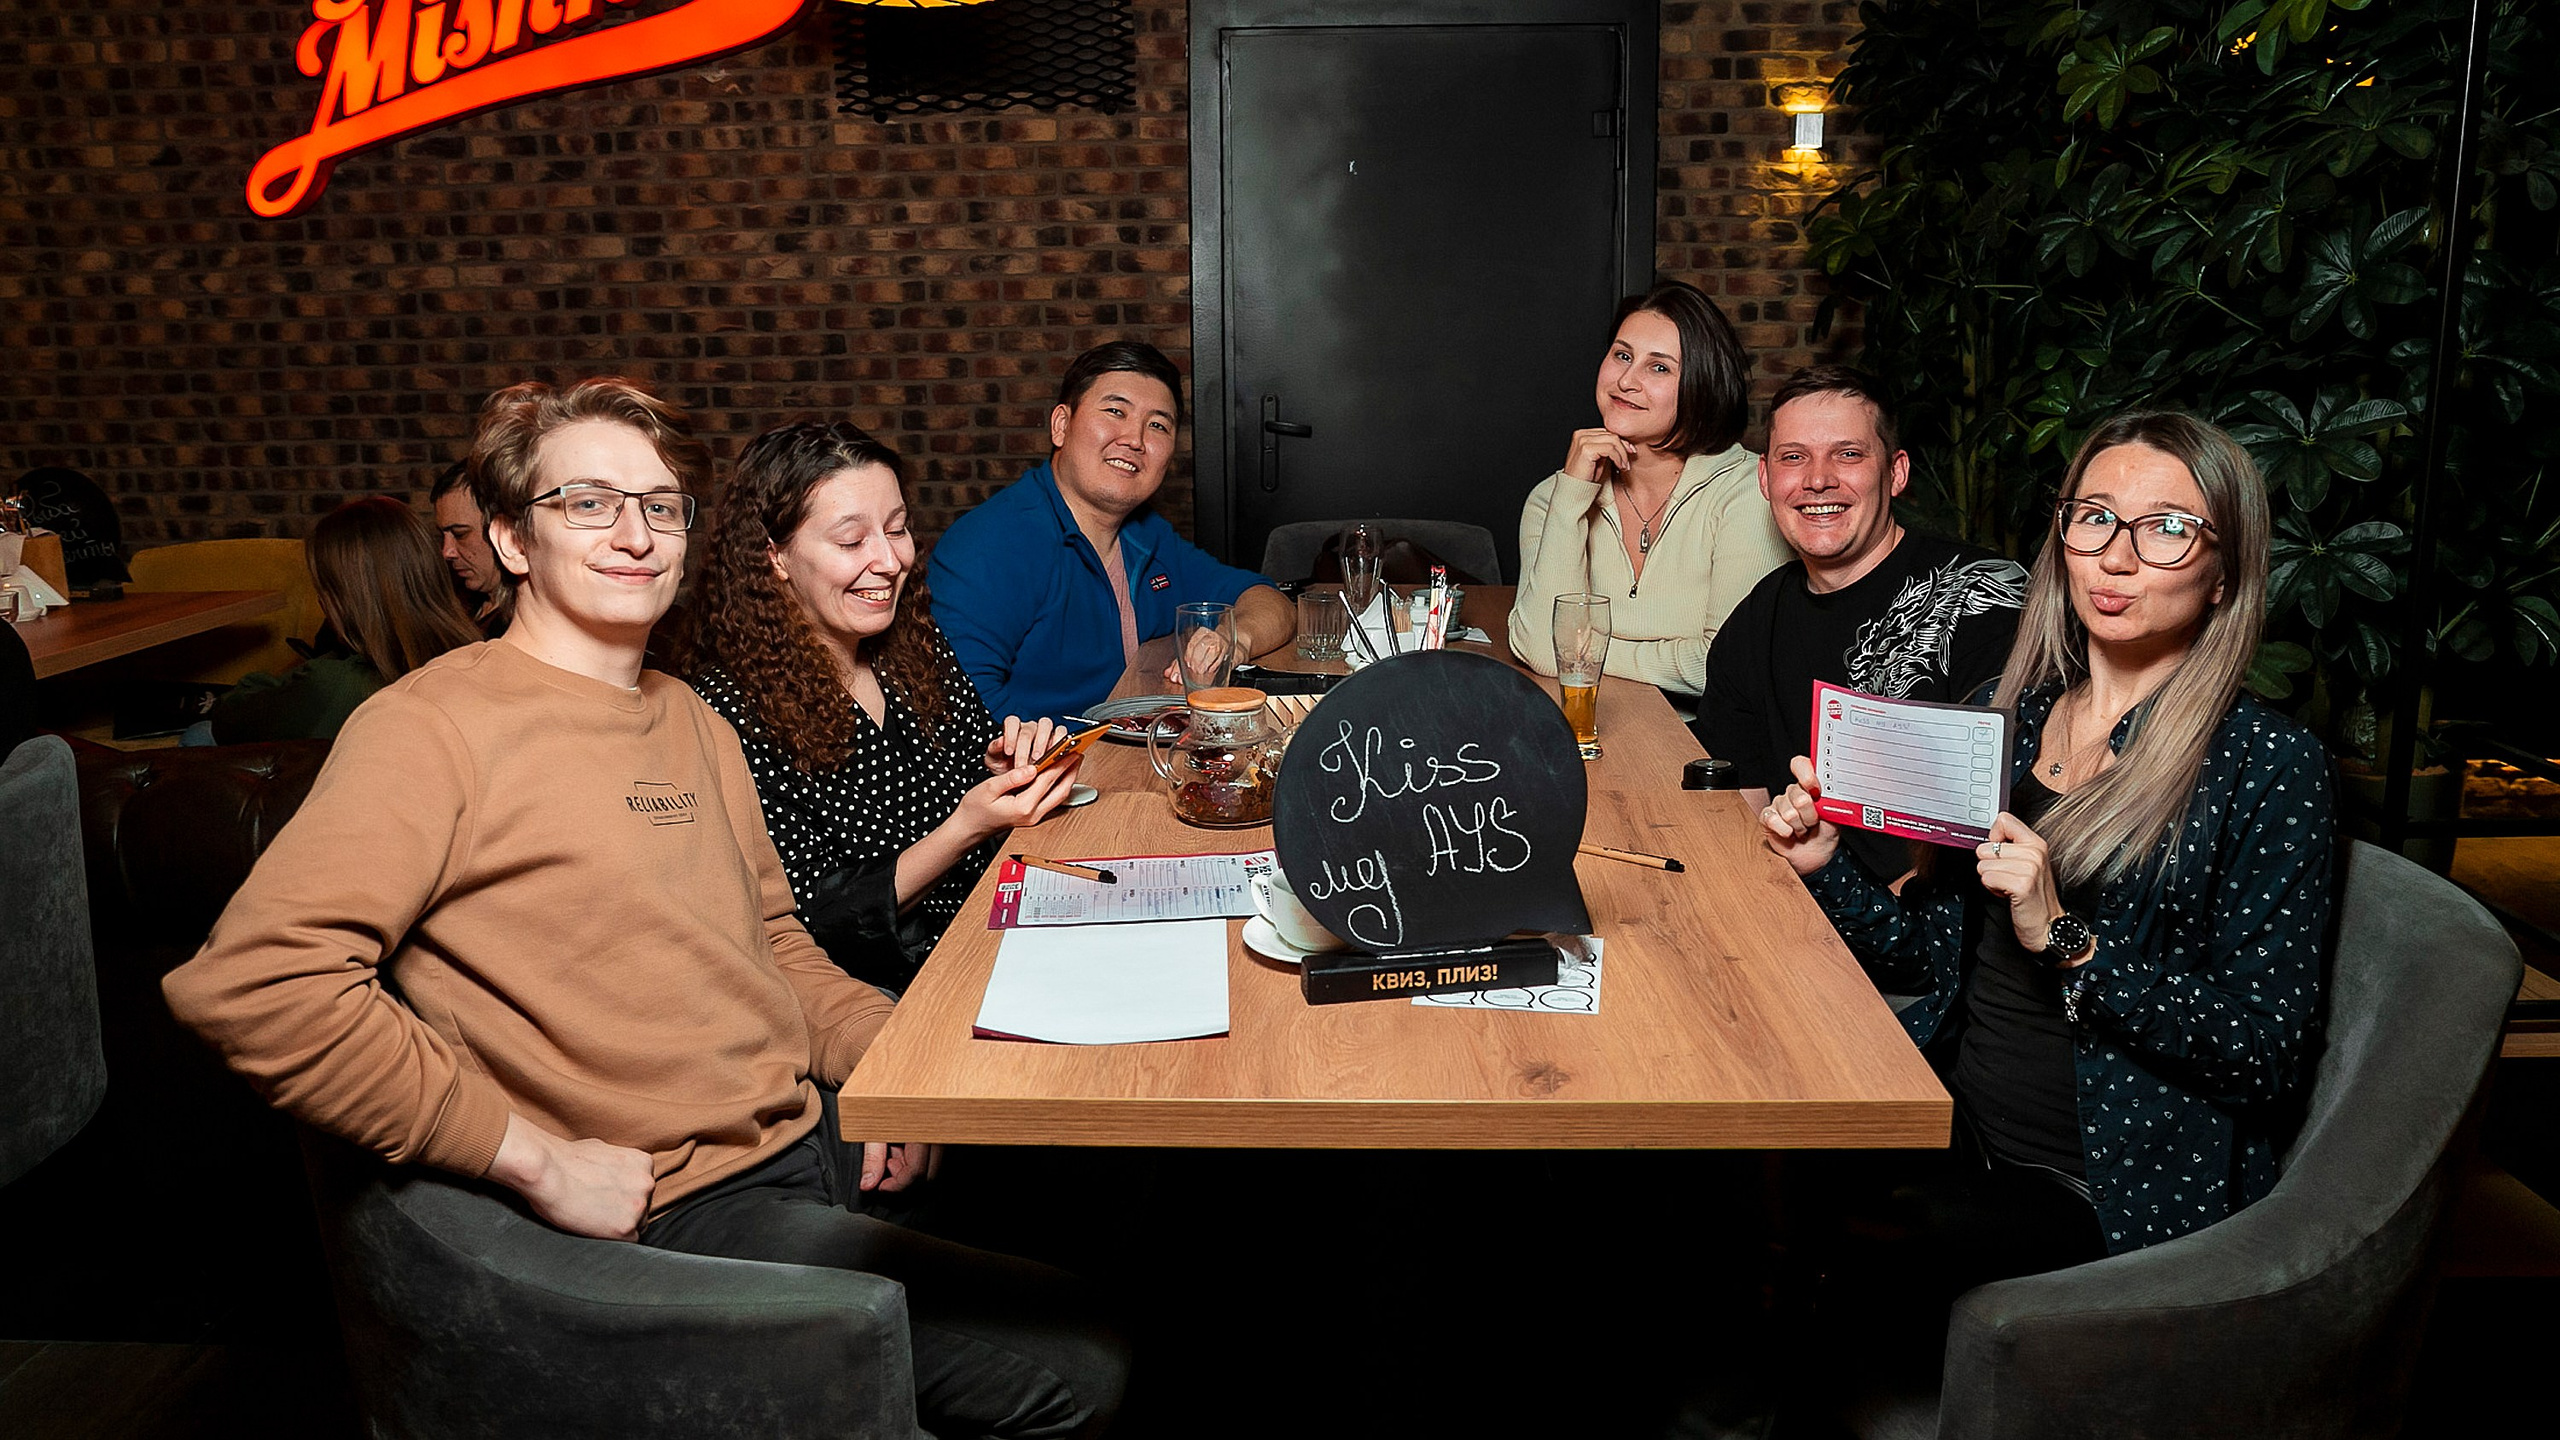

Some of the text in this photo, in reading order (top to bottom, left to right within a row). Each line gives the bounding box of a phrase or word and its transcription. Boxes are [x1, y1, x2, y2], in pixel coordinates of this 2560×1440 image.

[1319, 719, 1501, 824] Kiss
[625, 792, 699, 813] RELIABILITY
[1372, 964, 1498, 991] КВИЗ, ПЛИЗ!
